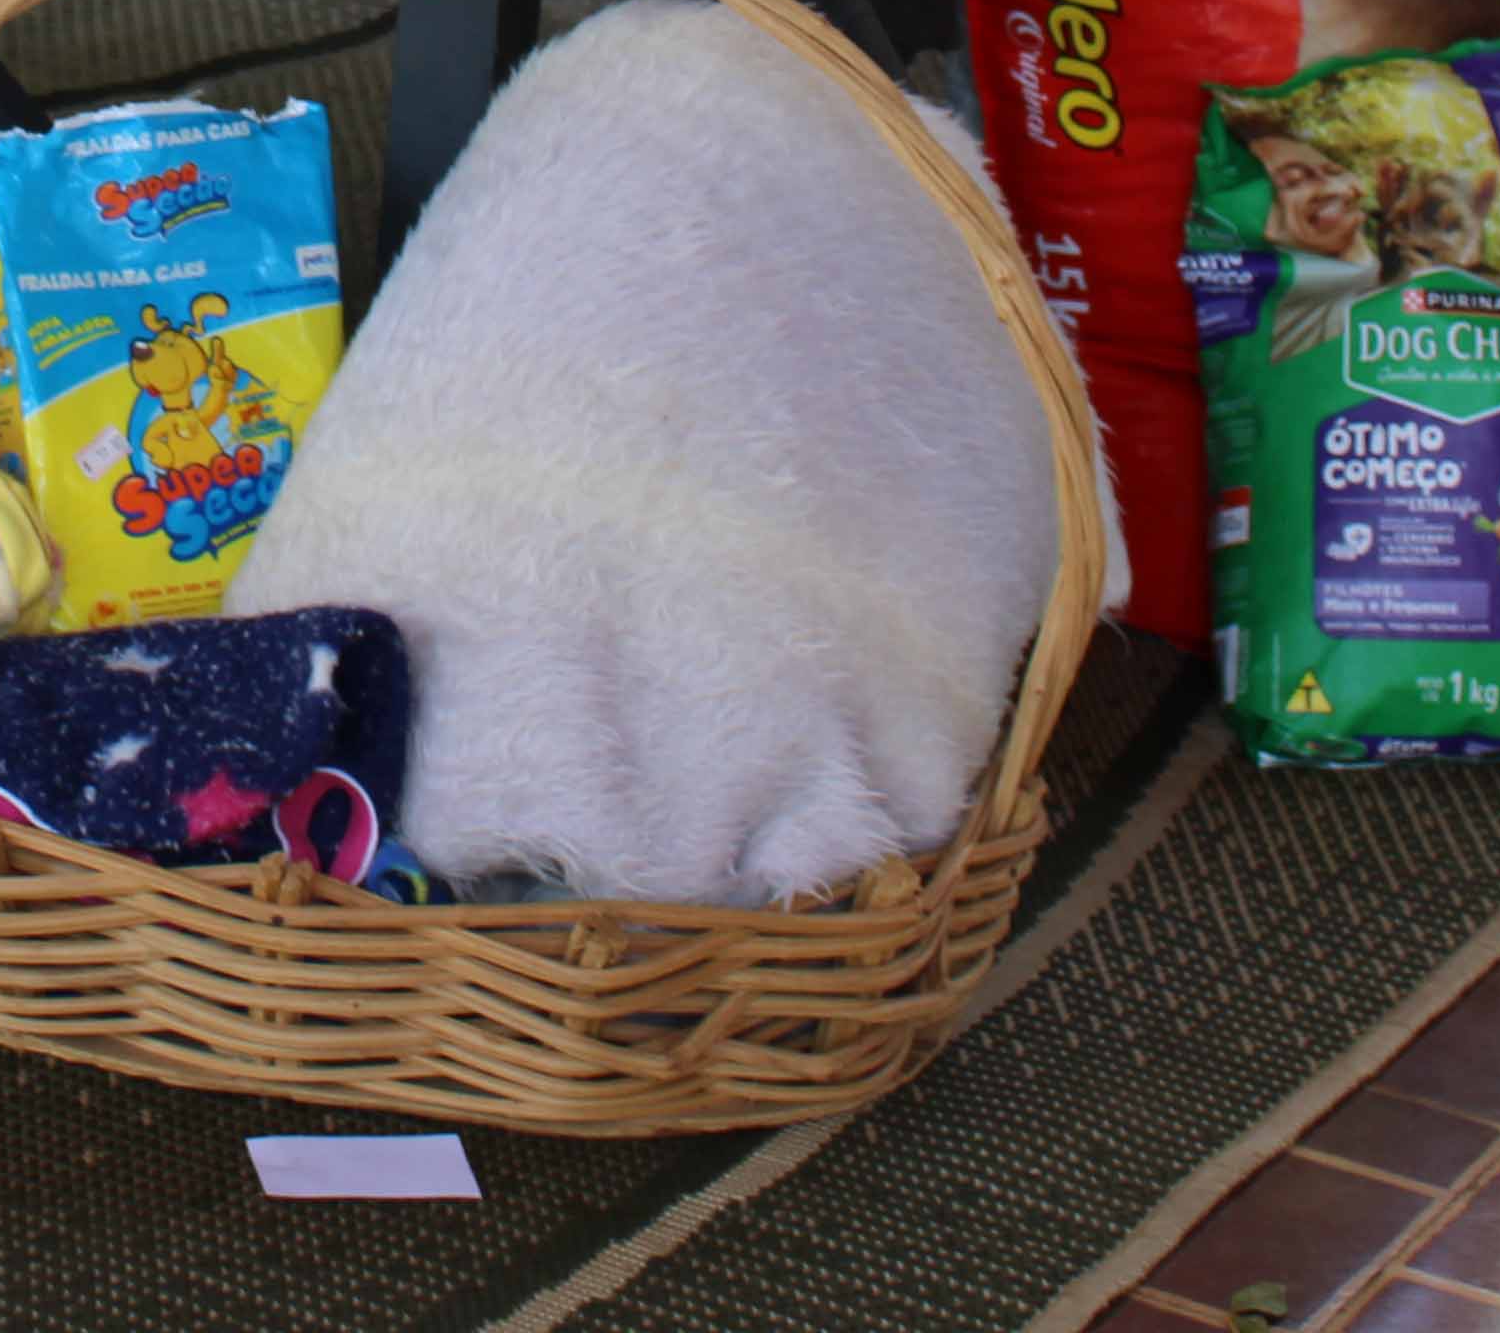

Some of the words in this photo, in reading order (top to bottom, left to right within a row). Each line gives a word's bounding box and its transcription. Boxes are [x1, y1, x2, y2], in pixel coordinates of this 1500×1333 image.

[156, 129, 205, 149] PARA
[18, 273, 95, 293] FRALDAS
[98, 267, 150, 287] PARA
[1358, 320, 1438, 362] DOG
[1324, 416, 1446, 456] ÓTIMO
[1321, 458, 1464, 496] COMEÇO
[1449, 669, 1465, 705] 1
[1467, 677, 1500, 714] kg
